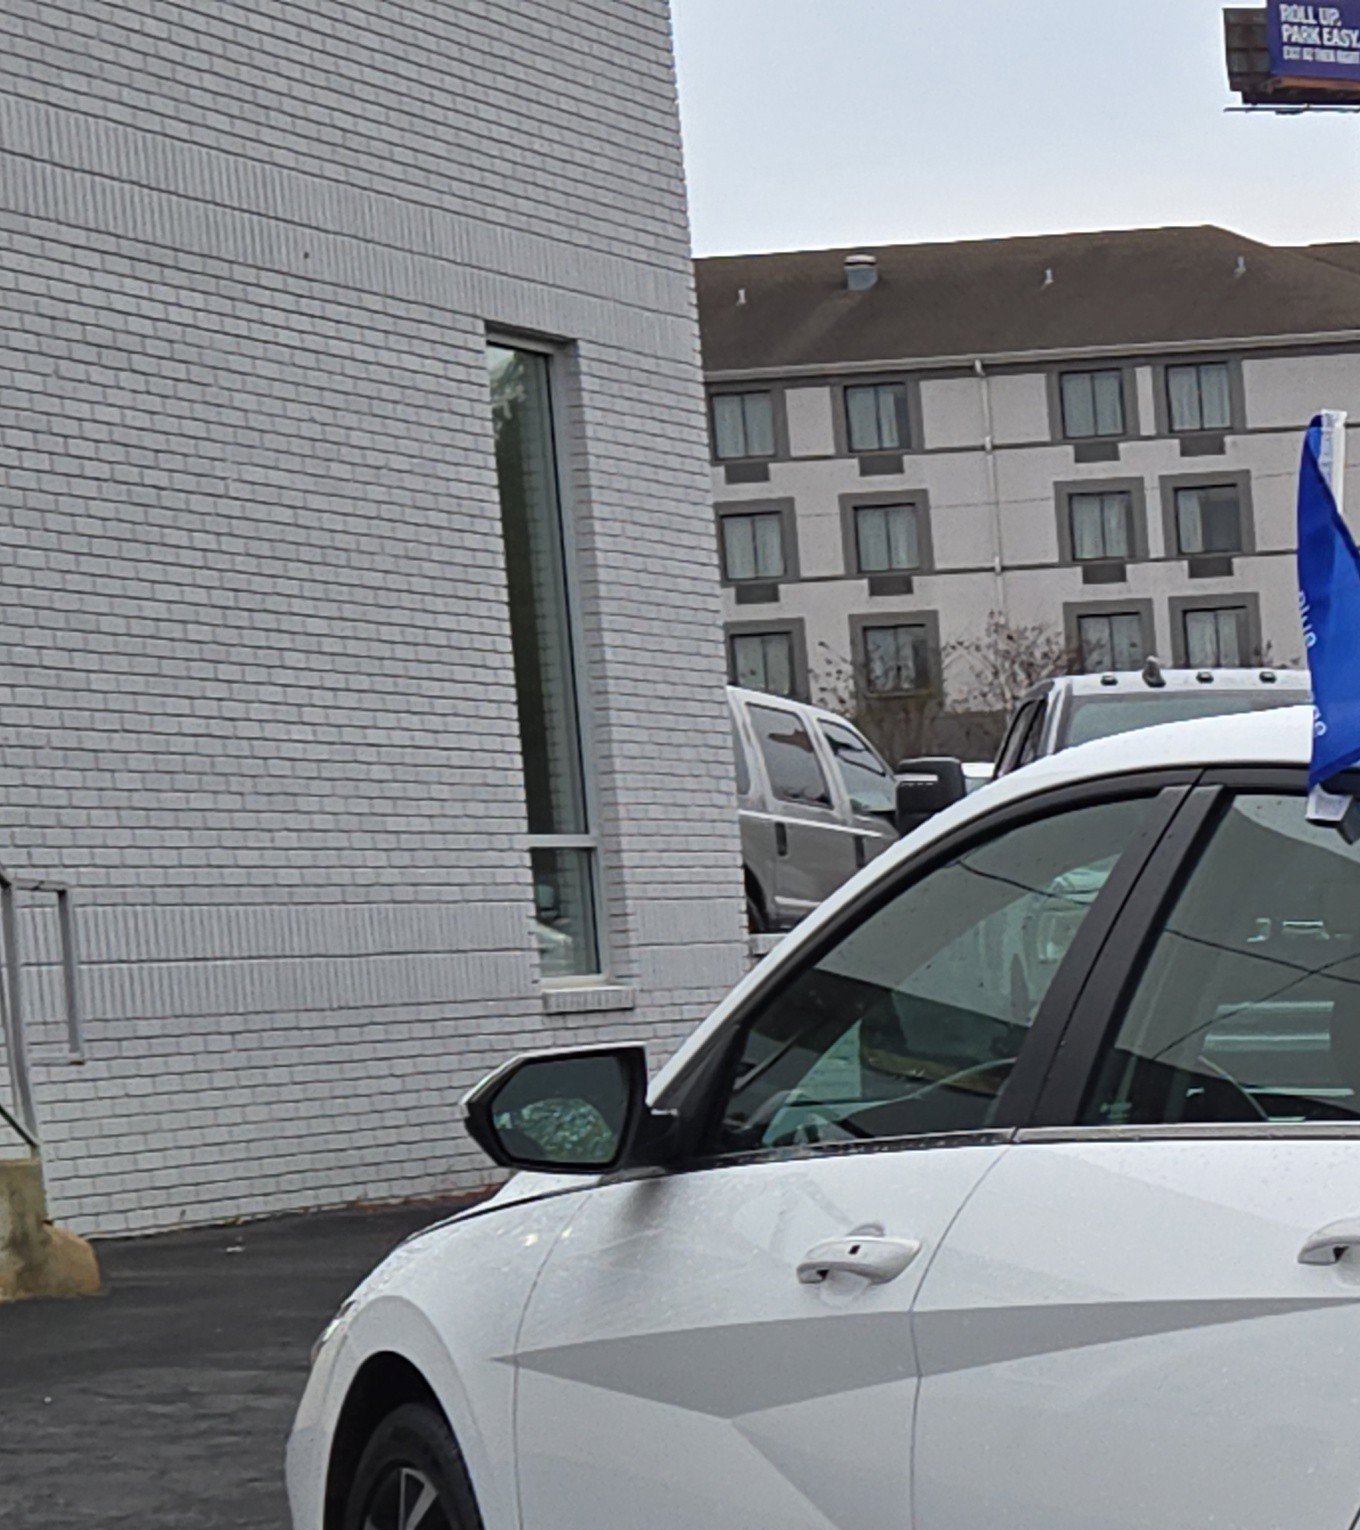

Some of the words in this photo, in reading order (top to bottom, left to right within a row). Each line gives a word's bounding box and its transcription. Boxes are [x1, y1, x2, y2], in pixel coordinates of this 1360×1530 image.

[1280, 4, 1317, 24] ROLL
[1319, 7, 1342, 27] UP.
[1282, 25, 1320, 45] PARK
